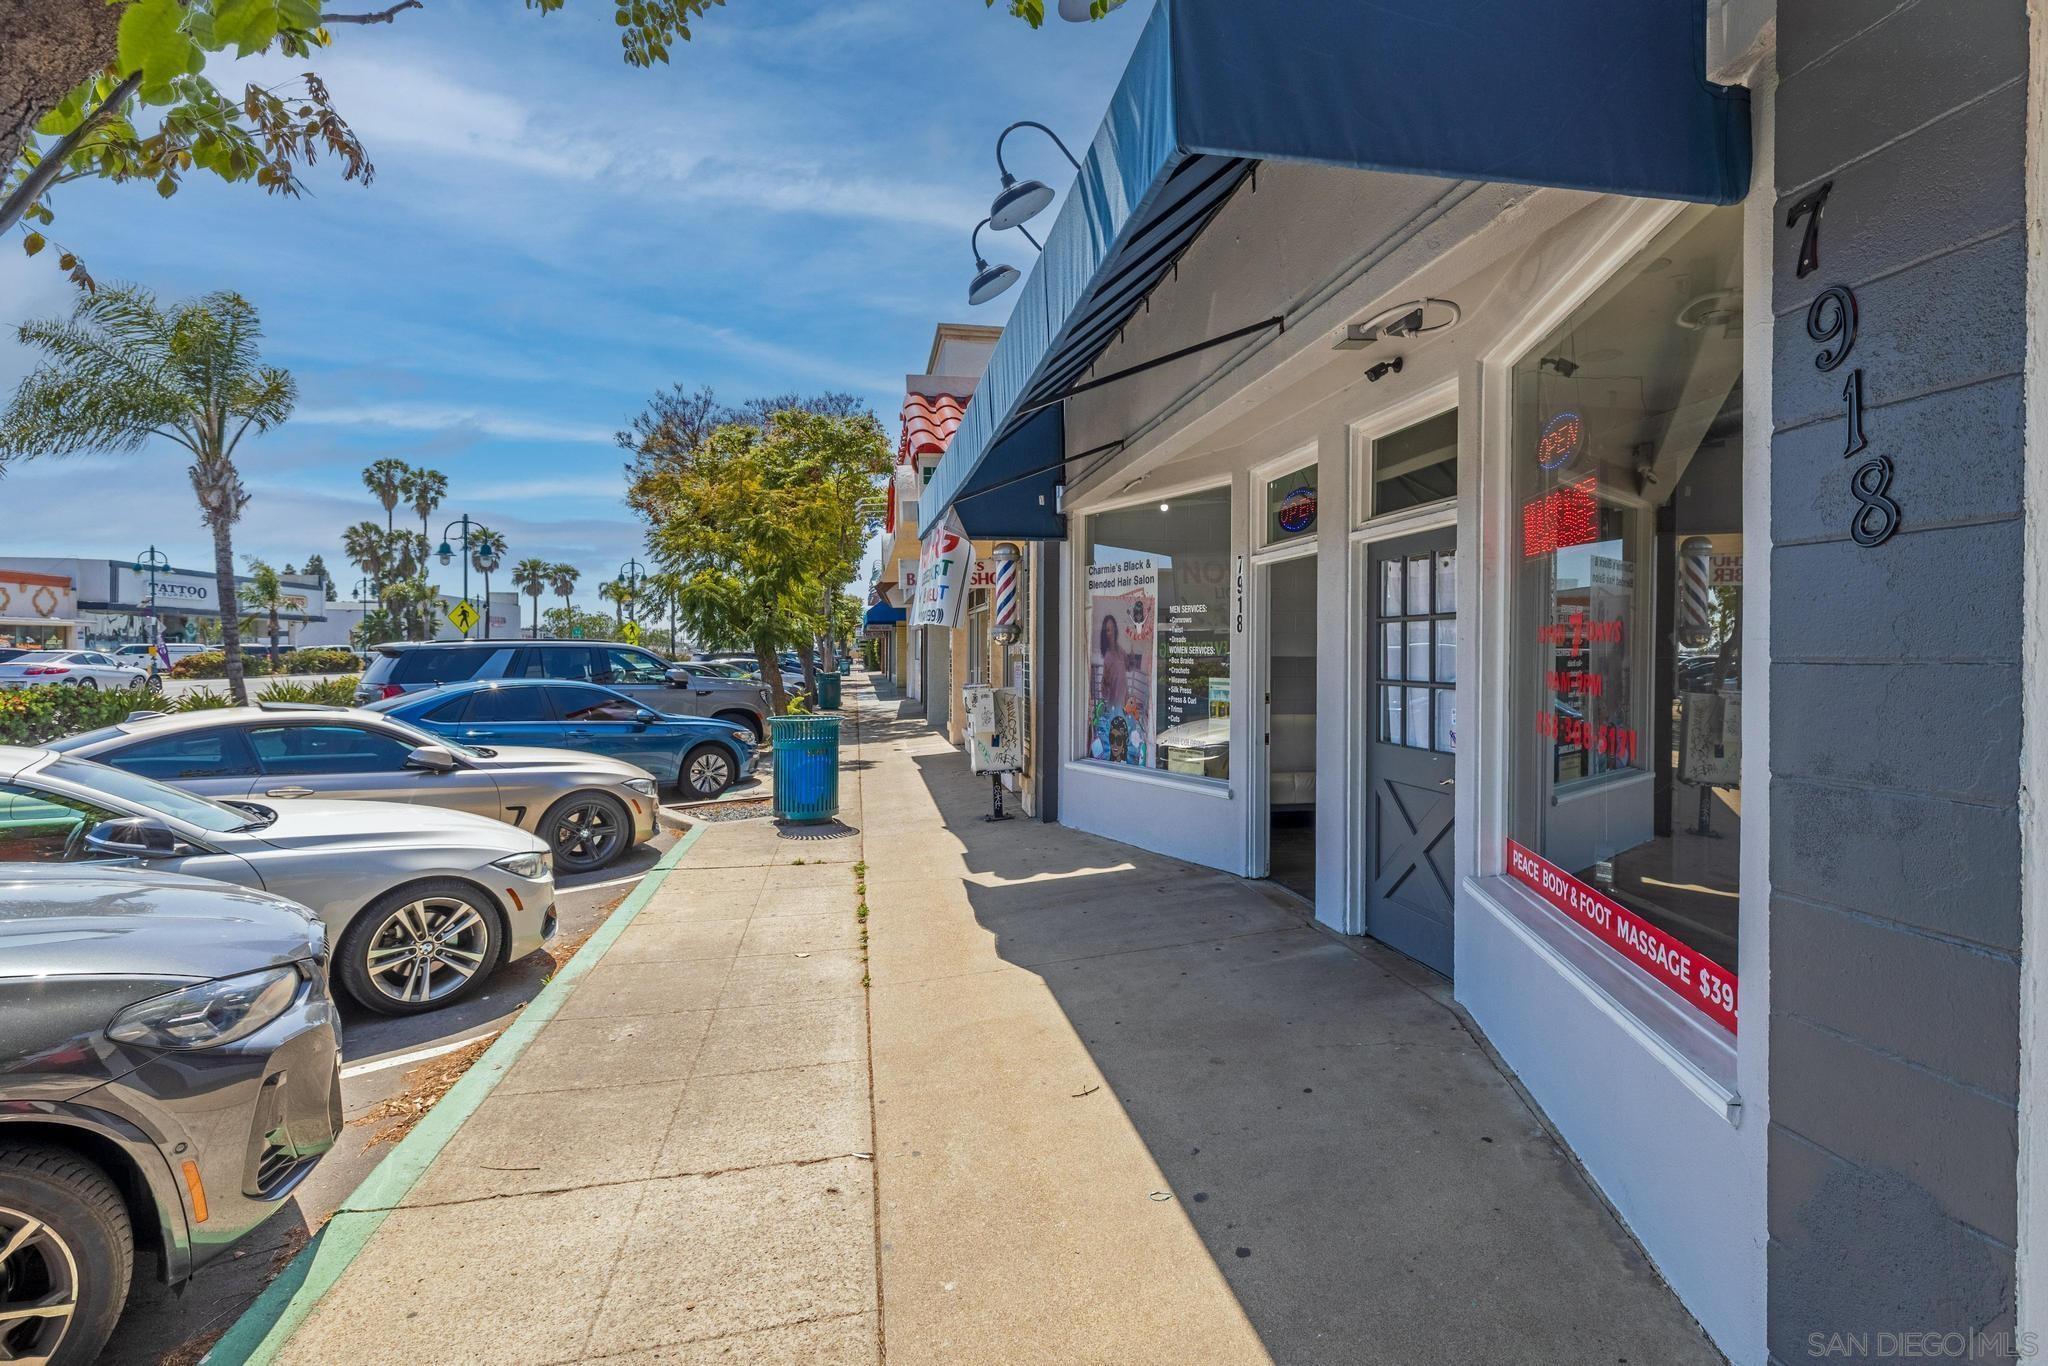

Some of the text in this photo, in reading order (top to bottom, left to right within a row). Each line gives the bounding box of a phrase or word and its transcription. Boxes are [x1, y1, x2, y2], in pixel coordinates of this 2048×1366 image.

[1785, 181, 1902, 547] 7918
[1539, 422, 1578, 462] OPEN
[1088, 558, 1151, 576] Charmie's Black &
[970, 572, 996, 585] SHO
[1088, 575, 1154, 589] Blended Hair Salon
[149, 582, 207, 599] TATTOO
[1169, 604, 1208, 613] MEN SERVICES:
[1569, 612, 1584, 657] 7
[1587, 619, 1624, 645] DAYS
[1168, 646, 1216, 655] WOMEN SERVICES:
[1180, 686, 1192, 694] Press
[1512, 849, 1539, 882] PEACE
[1542, 866, 1569, 902] BODY
[1570, 886, 1578, 908] &
[1579, 893, 1612, 930] FOOT
[1617, 916, 1691, 984] MASSAGE
